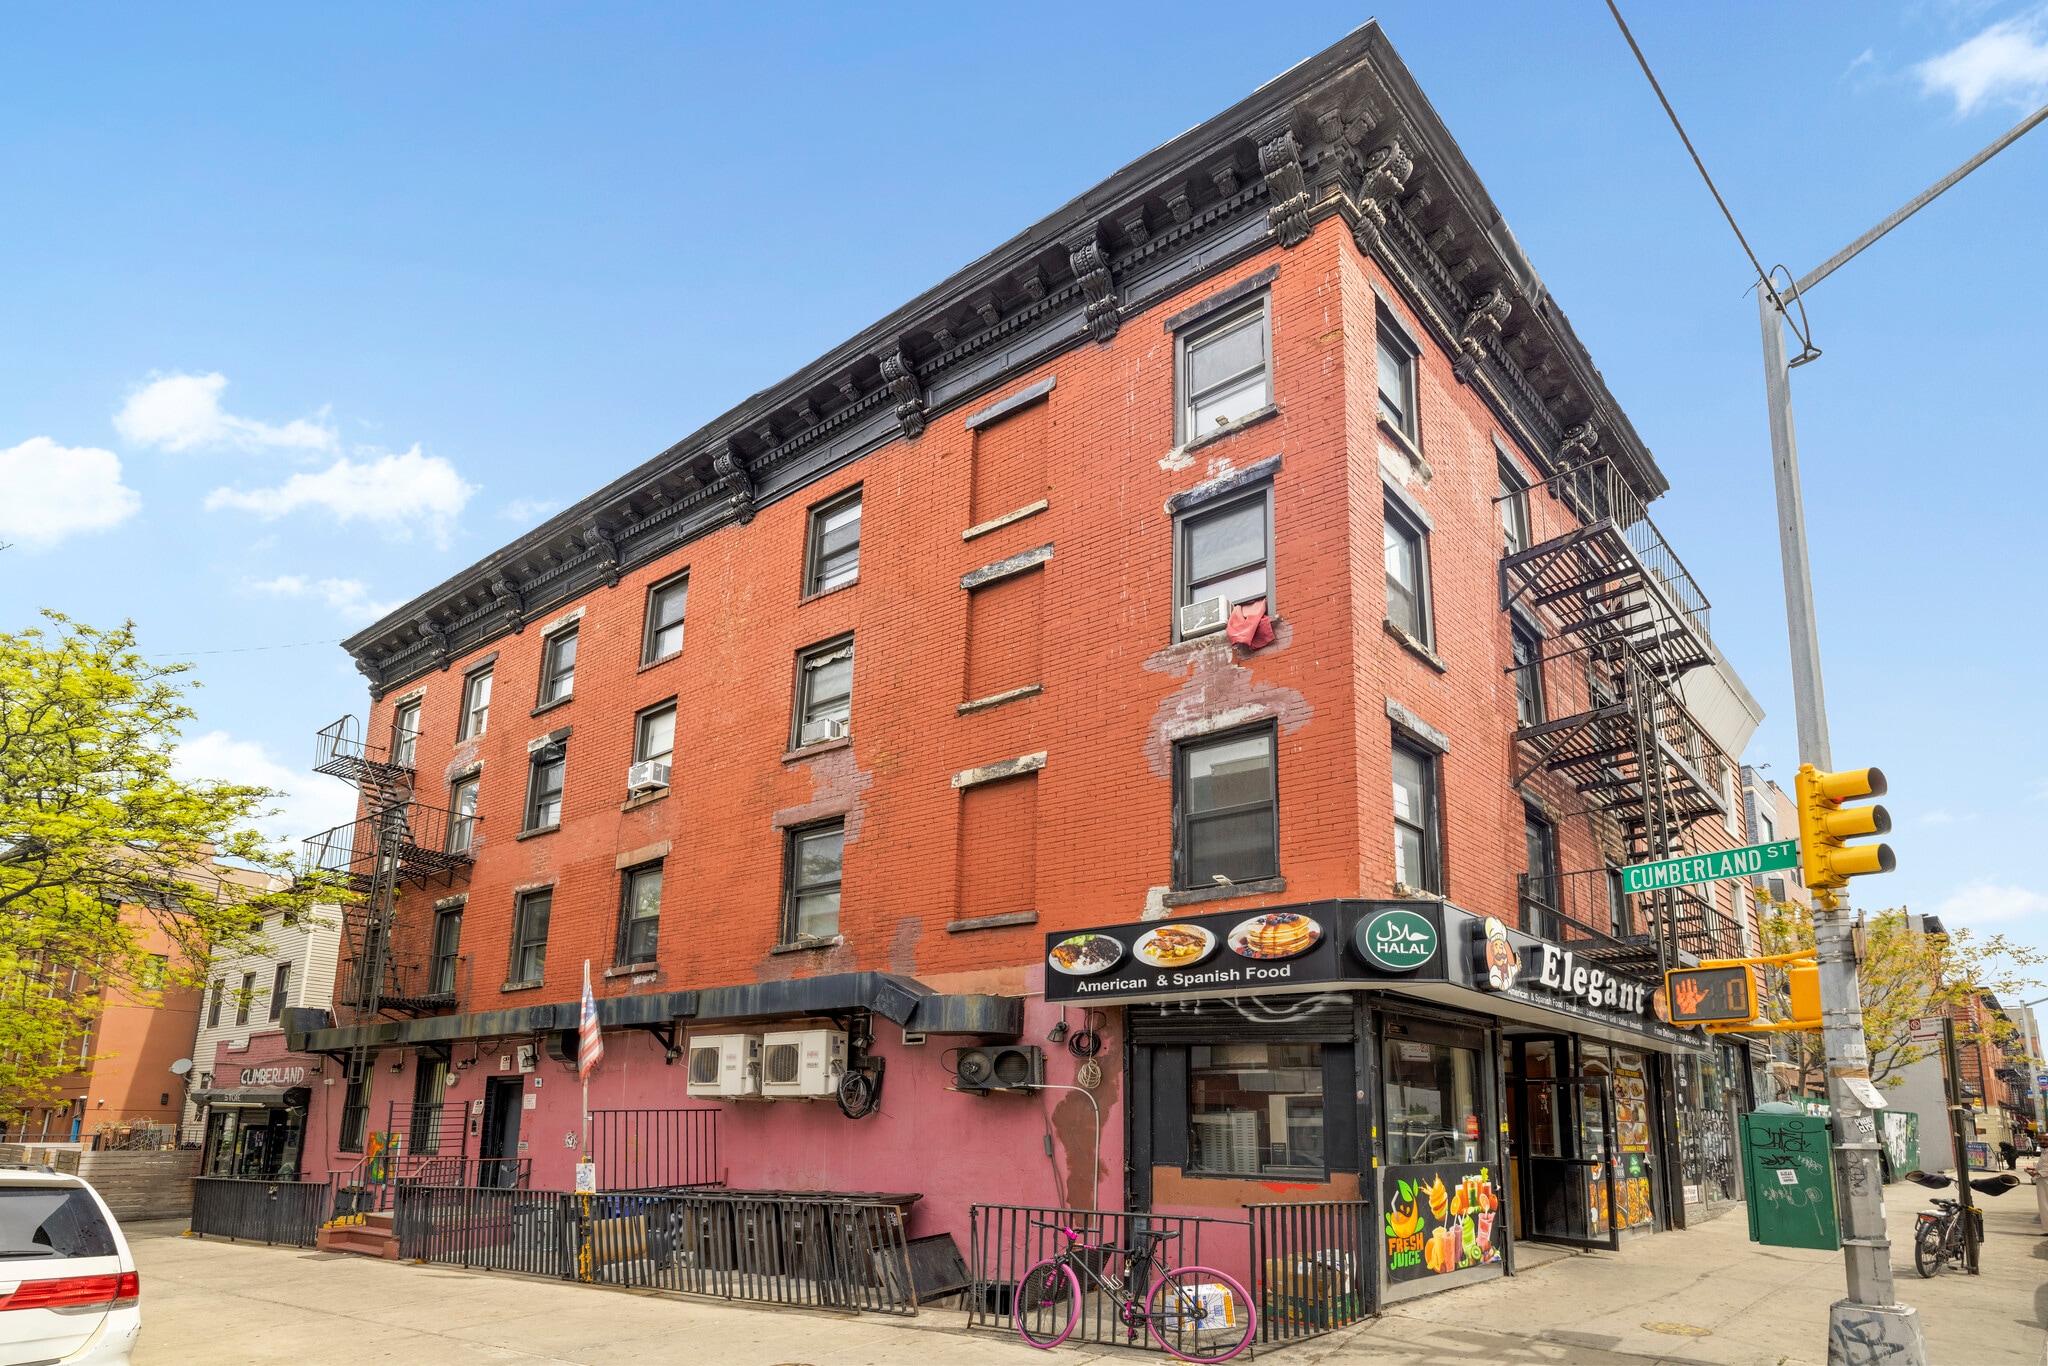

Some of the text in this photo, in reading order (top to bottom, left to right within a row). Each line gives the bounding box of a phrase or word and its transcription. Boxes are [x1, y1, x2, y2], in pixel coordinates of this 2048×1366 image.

[1630, 844, 1791, 889] CUMBERLAND ST
[1377, 942, 1430, 955] HALAL
[1076, 964, 1291, 993] American & Spanish Food
[1540, 943, 1645, 1014] Elegant
[1507, 989, 1530, 1001] American
[1535, 994, 1552, 1006] Spanish
[1552, 998, 1563, 1009] Food
[240, 1066, 305, 1085] CUMBERLAND
[1467, 1148, 1474, 1163] A
[1388, 1231, 1425, 1256] FRESH
